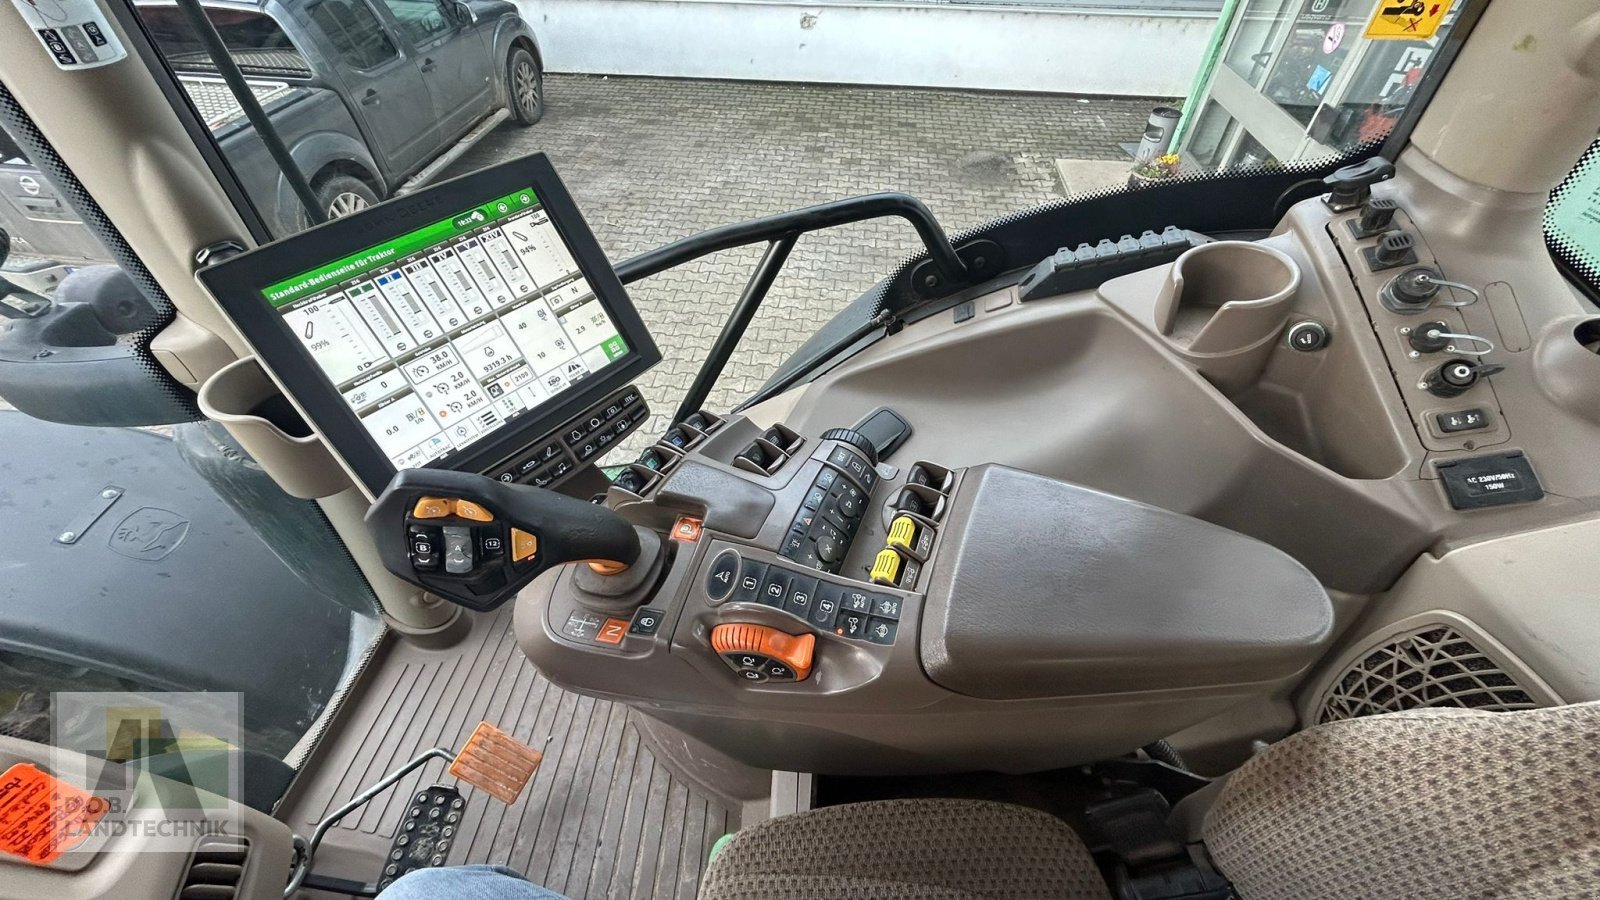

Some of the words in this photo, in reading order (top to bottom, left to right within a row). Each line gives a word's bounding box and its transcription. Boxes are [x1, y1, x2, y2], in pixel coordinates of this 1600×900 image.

[483, 230, 500, 242] XIV
[520, 245, 536, 255] 94%
[270, 264, 355, 300] Standard-Bedienseite
[355, 259, 368, 267] für
[367, 248, 394, 262] Traktor
[571, 286, 578, 294] N
[303, 305, 319, 315] 100
[576, 325, 586, 334] 2.9
[311, 339, 330, 351] 99%
[430, 351, 448, 364] 38.0
[436, 359, 452, 370] KM/H
[483, 357, 506, 372] 9319.3
[451, 371, 464, 382] 2.0
[548, 376, 560, 386] ISO
[454, 378, 470, 389] KM/H
[464, 390, 477, 401] 2.0
[467, 397, 483, 408] KM/H
[386, 425, 399, 435] 0.0
[1485, 482, 1505, 490] 150W
[723, 571, 731, 583] AUTO
[770, 586, 780, 594] 2
[795, 594, 805, 602] 3
[821, 601, 832, 611] 4
[606, 625, 622, 636] N
